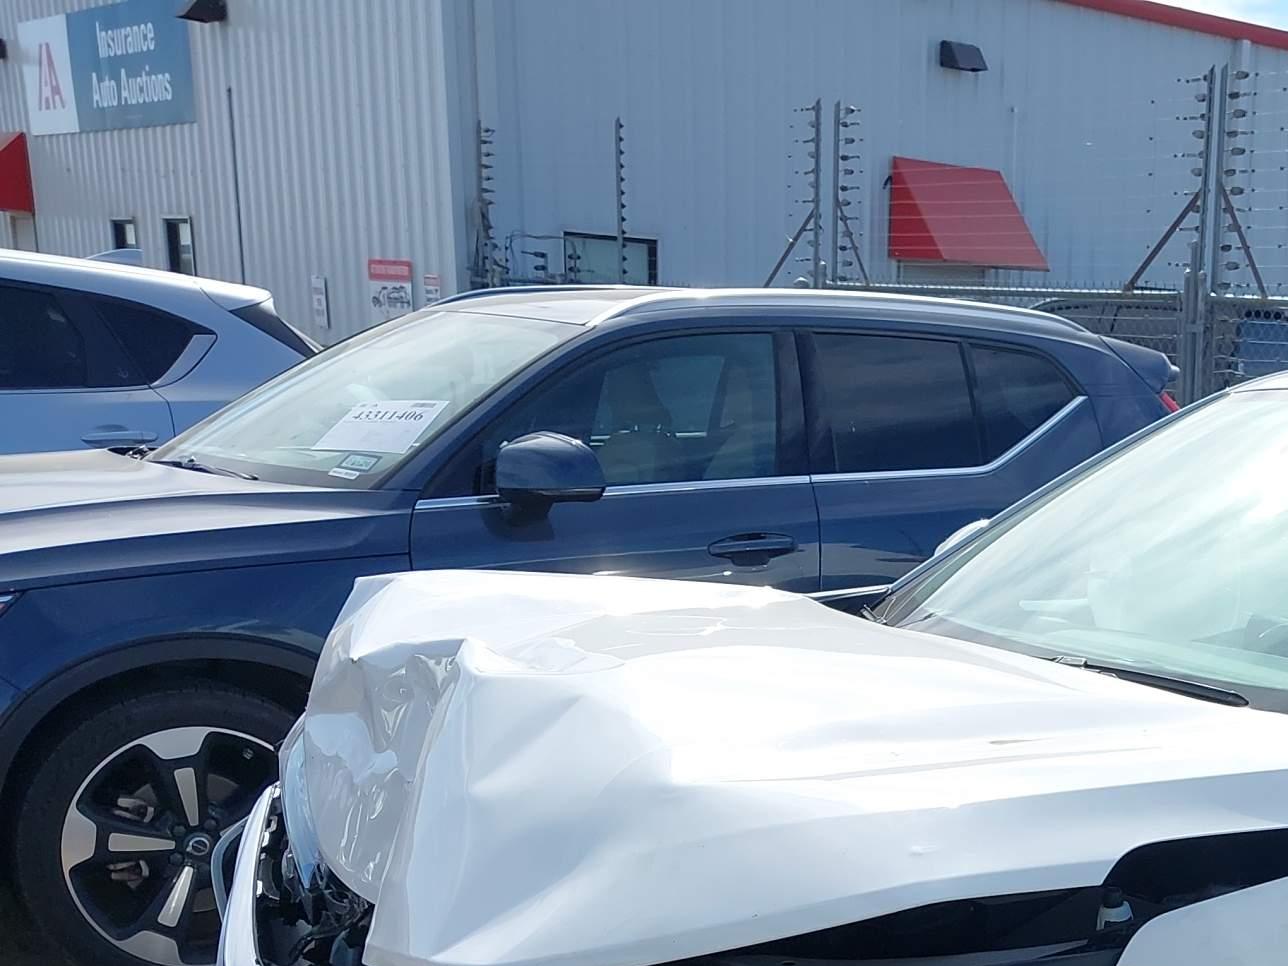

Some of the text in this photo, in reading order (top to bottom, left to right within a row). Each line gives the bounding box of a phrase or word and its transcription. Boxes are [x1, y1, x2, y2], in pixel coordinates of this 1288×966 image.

[95, 20, 156, 58] Insurance
[91, 65, 173, 109] Auto Auctions
[351, 409, 425, 422] 43311406
